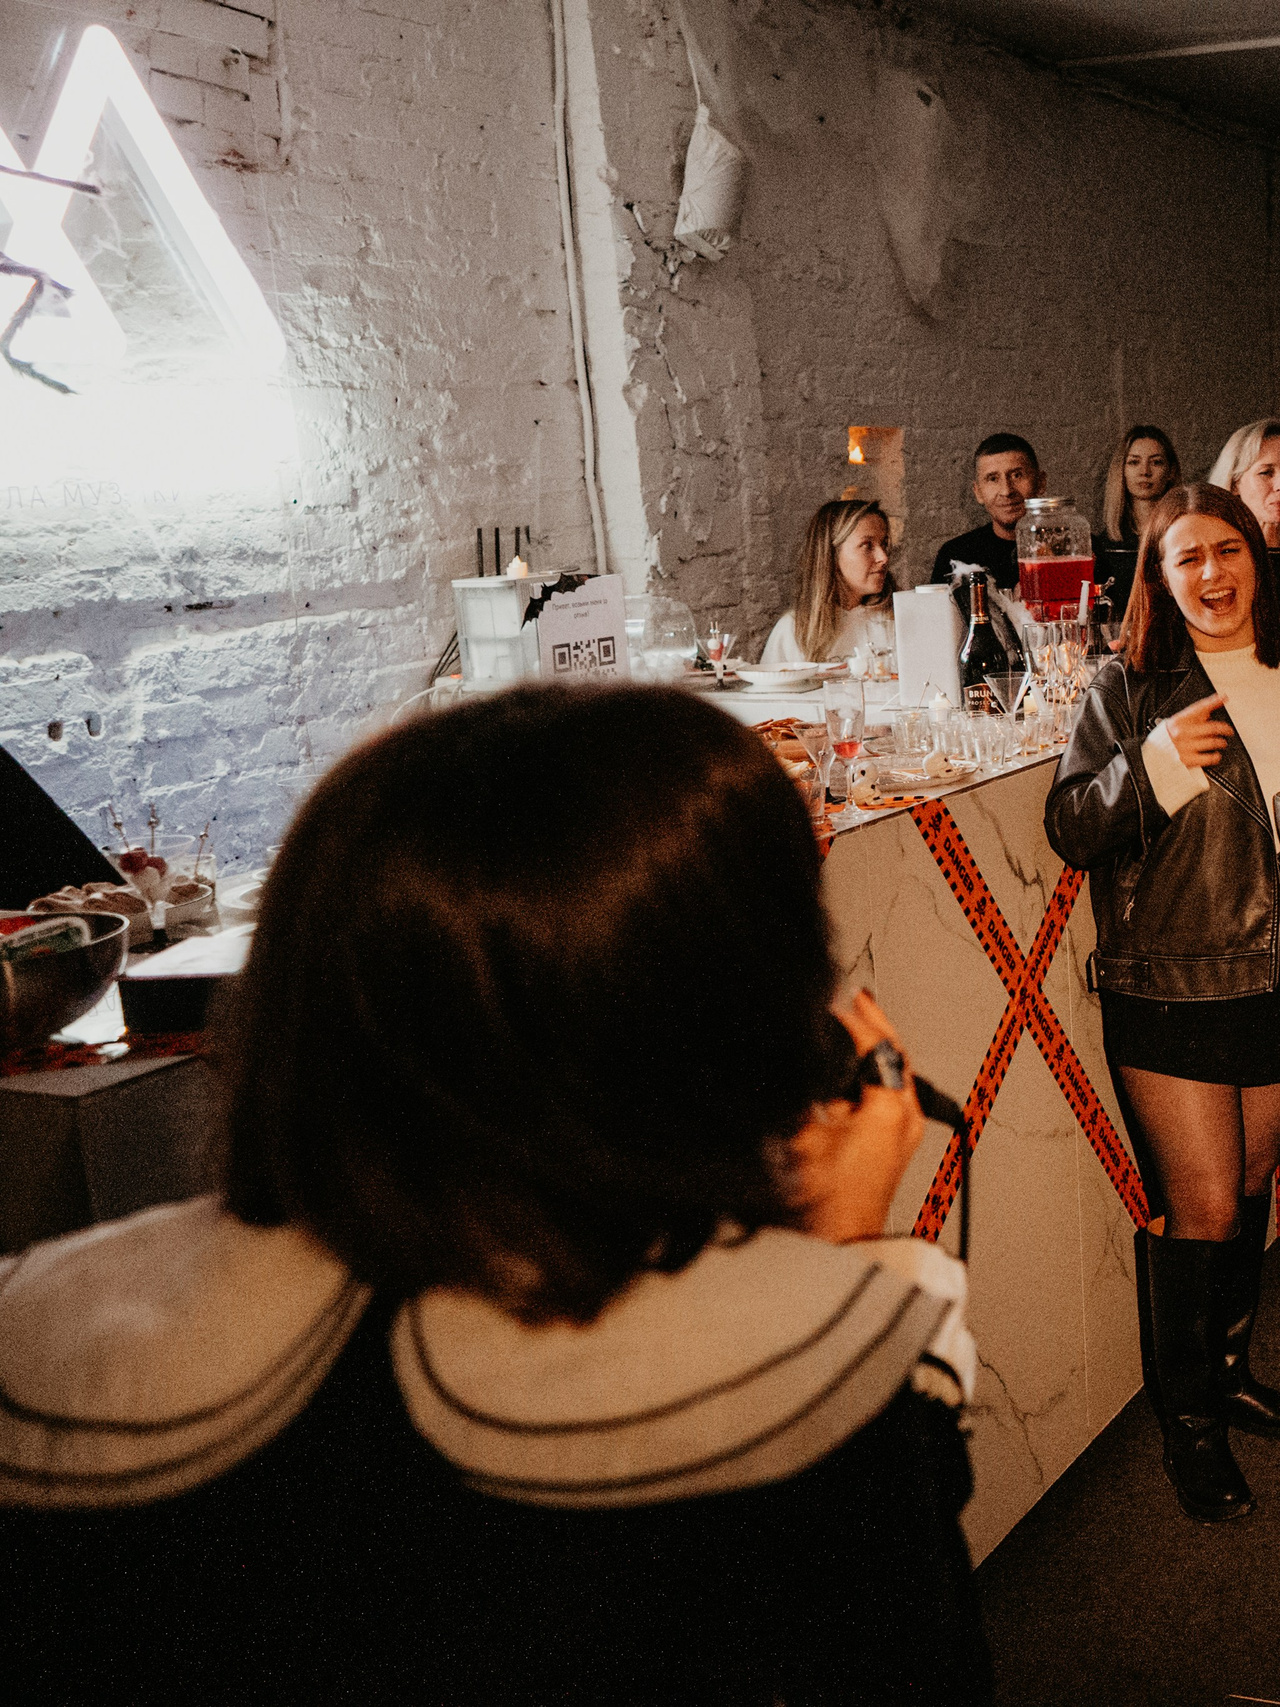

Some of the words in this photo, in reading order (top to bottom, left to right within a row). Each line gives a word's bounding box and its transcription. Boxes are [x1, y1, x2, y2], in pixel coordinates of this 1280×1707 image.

[62, 481, 180, 507] МУЗКИ
[968, 690, 993, 698] BRUN
[943, 836, 974, 894] DANGER
[987, 919, 1016, 972] DANGER
[1032, 1004, 1054, 1042] ANGER
[1065, 1064, 1089, 1109] DANGER
[1098, 1124, 1121, 1167] DANGER
[943, 1117, 974, 1186] DANR
[989, 1014, 1018, 1080] DANGER
[1029, 919, 1056, 979] DANGER
